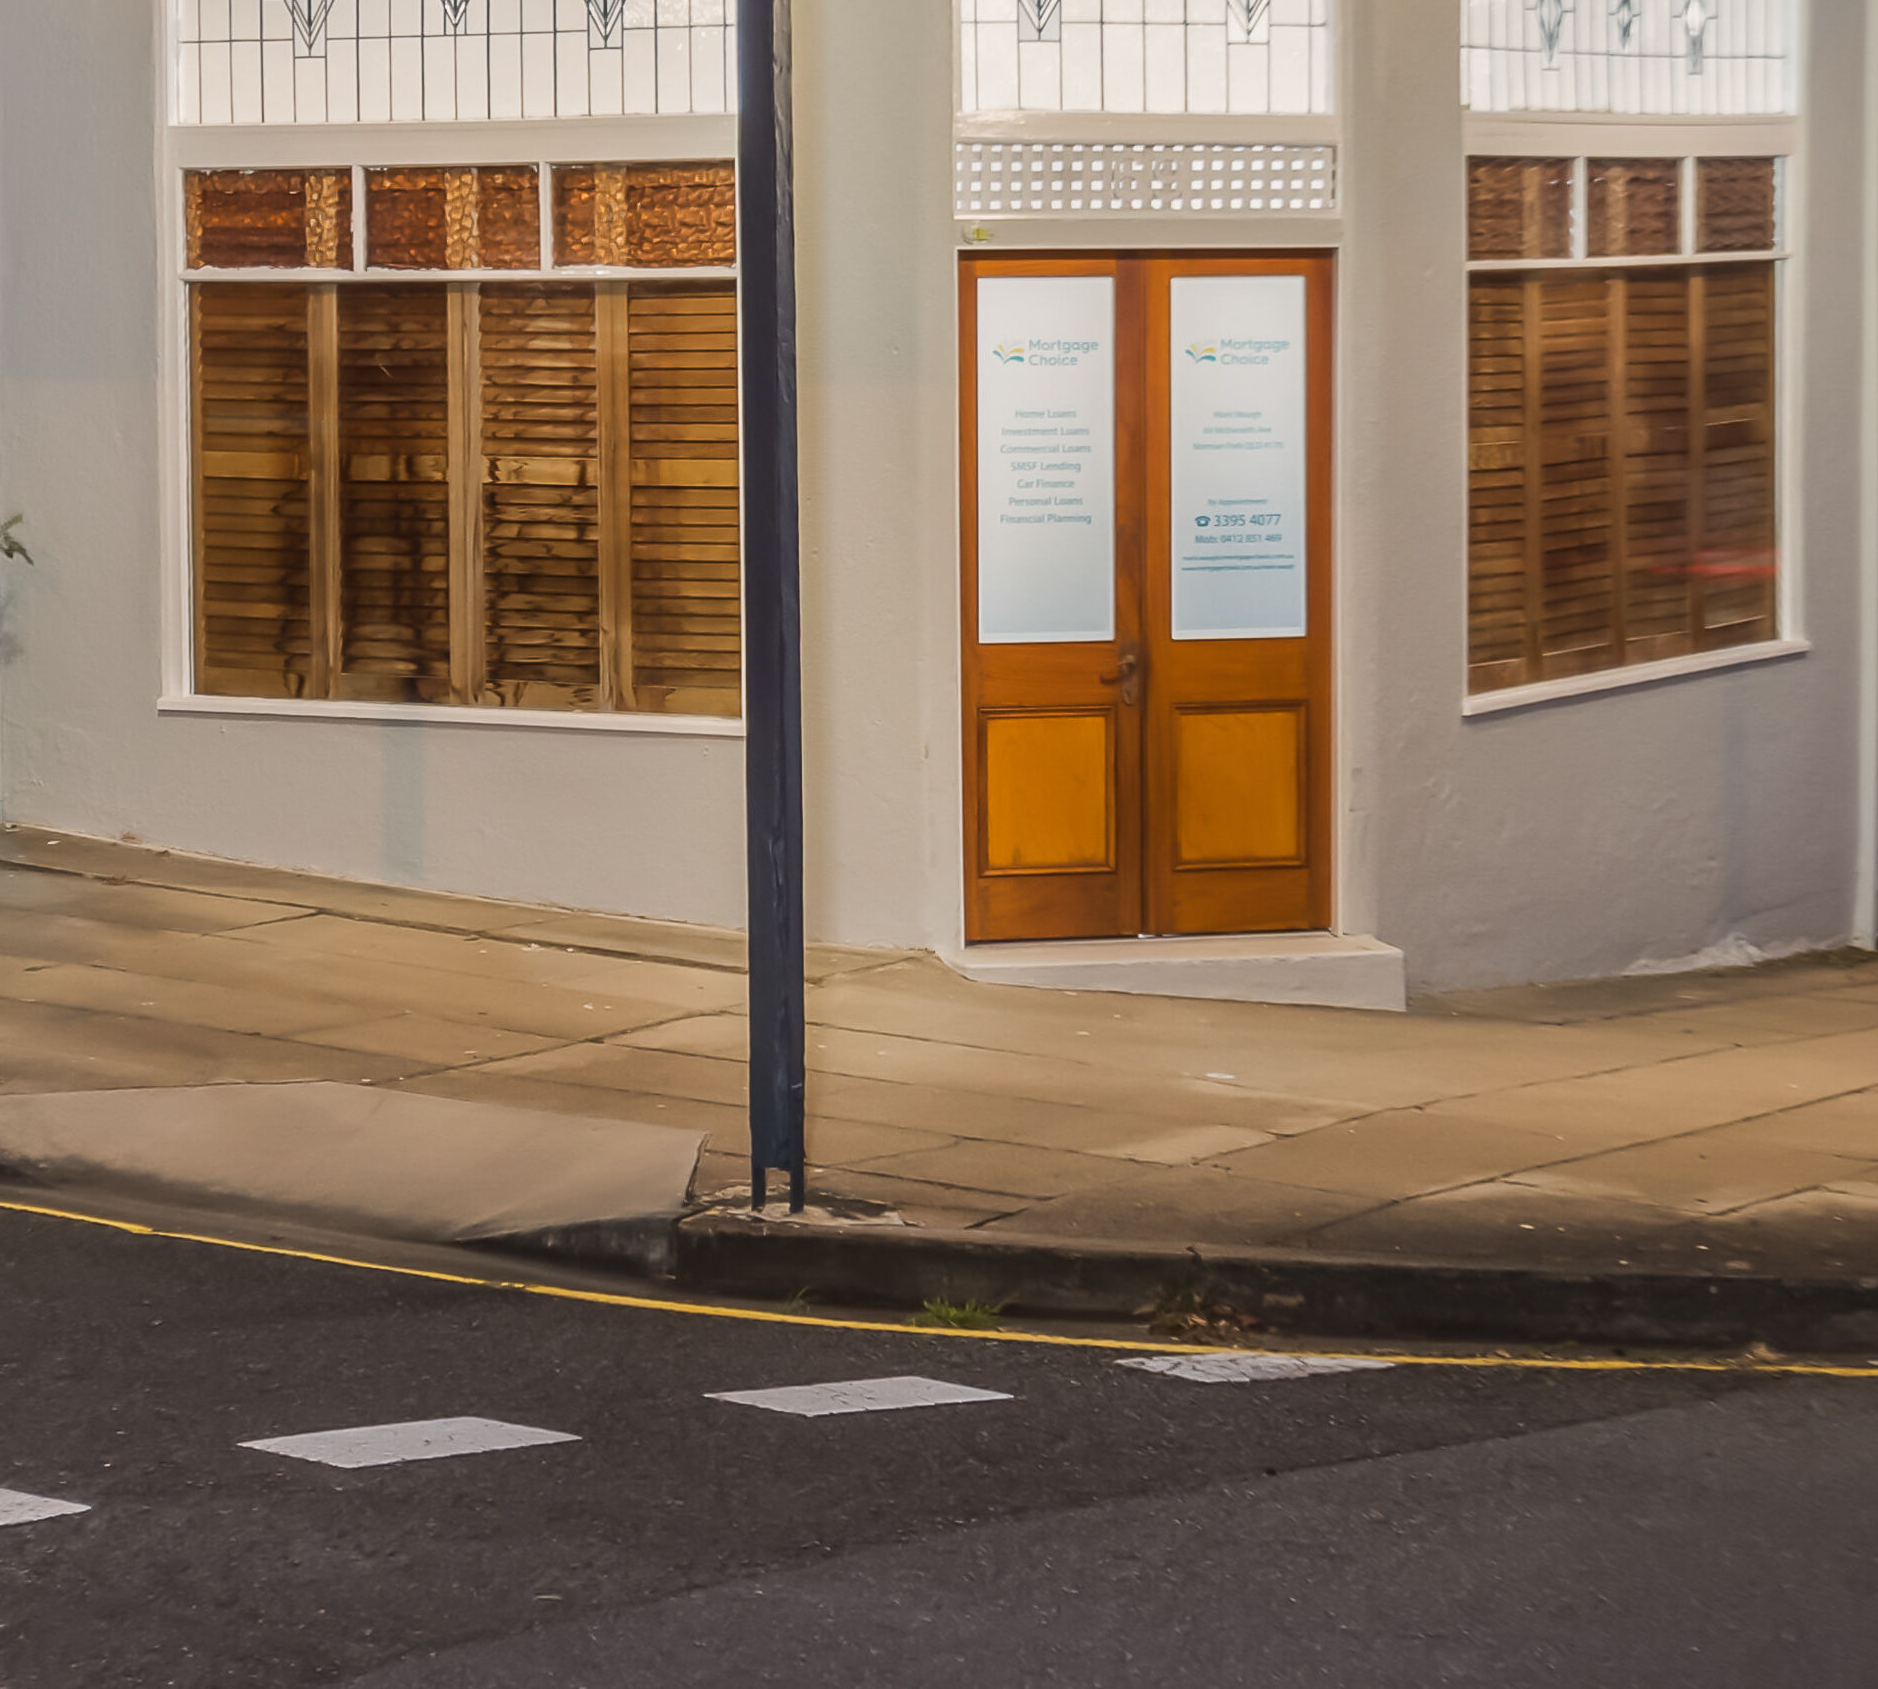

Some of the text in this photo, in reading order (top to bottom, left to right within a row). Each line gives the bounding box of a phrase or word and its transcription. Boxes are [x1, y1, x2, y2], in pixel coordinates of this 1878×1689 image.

[1029, 339, 1099, 354] Mortgage
[1220, 338, 1290, 353] Mortgage
[1028, 354, 1078, 366] Choice
[1220, 353, 1269, 365] Choice
[1047, 409, 1076, 418] Loans
[1001, 426, 1090, 436] Investment Loans
[1000, 443, 1092, 454] Commercial Loans
[1040, 461, 1082, 473] Lending
[1017, 479, 1075, 489] Car Finance
[1008, 496, 1084, 506] Personal Loans
[1000, 513, 1092, 525] Financial Planning
[1213, 513, 1282, 527] 3395 4077
